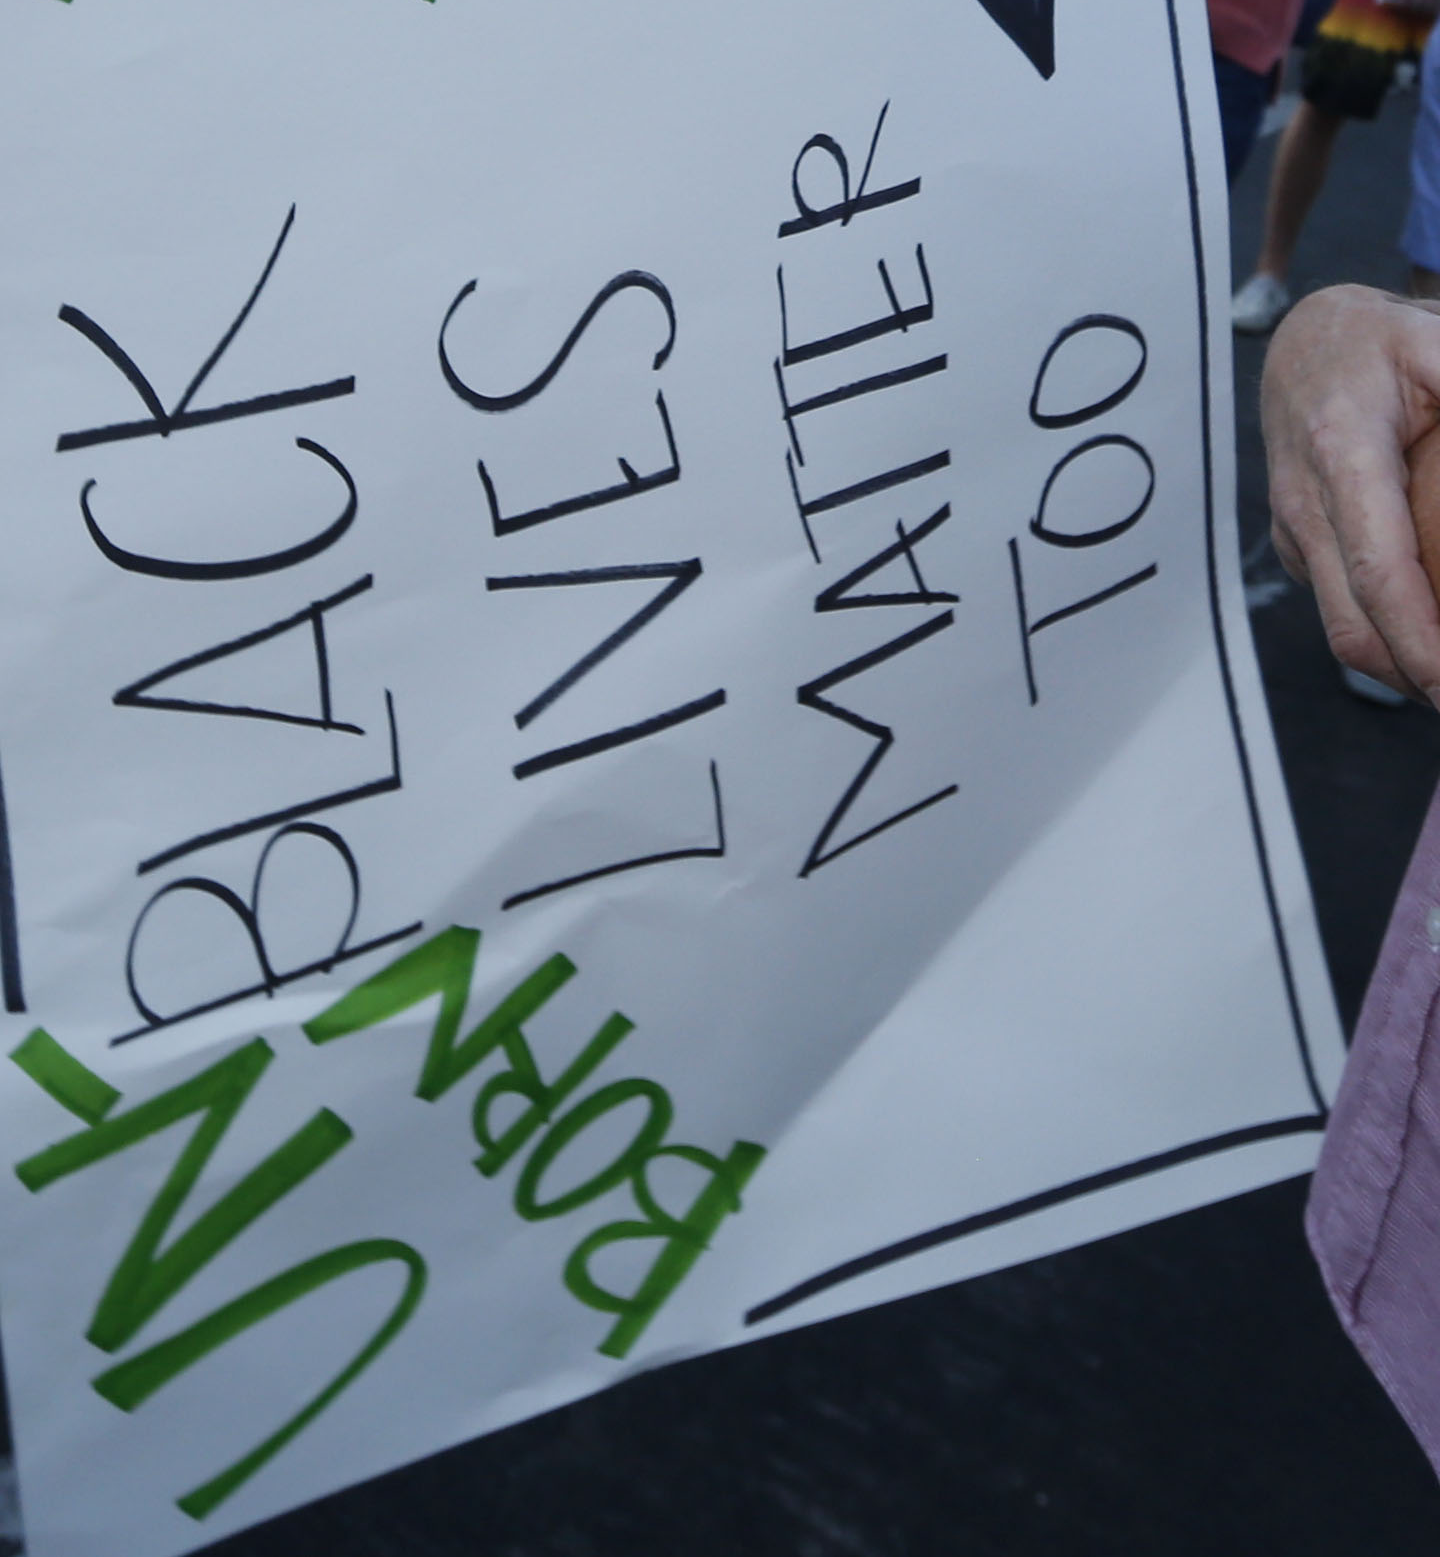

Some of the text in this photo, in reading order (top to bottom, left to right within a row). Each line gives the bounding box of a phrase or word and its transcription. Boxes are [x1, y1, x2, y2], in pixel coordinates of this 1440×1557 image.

[56, 203, 424, 1047] BLACK
[438, 269, 727, 911] LIVES
[772, 100, 960, 879] MATTER
[1008, 313, 1158, 707] TOO
[304, 926, 766, 1360] BORN
